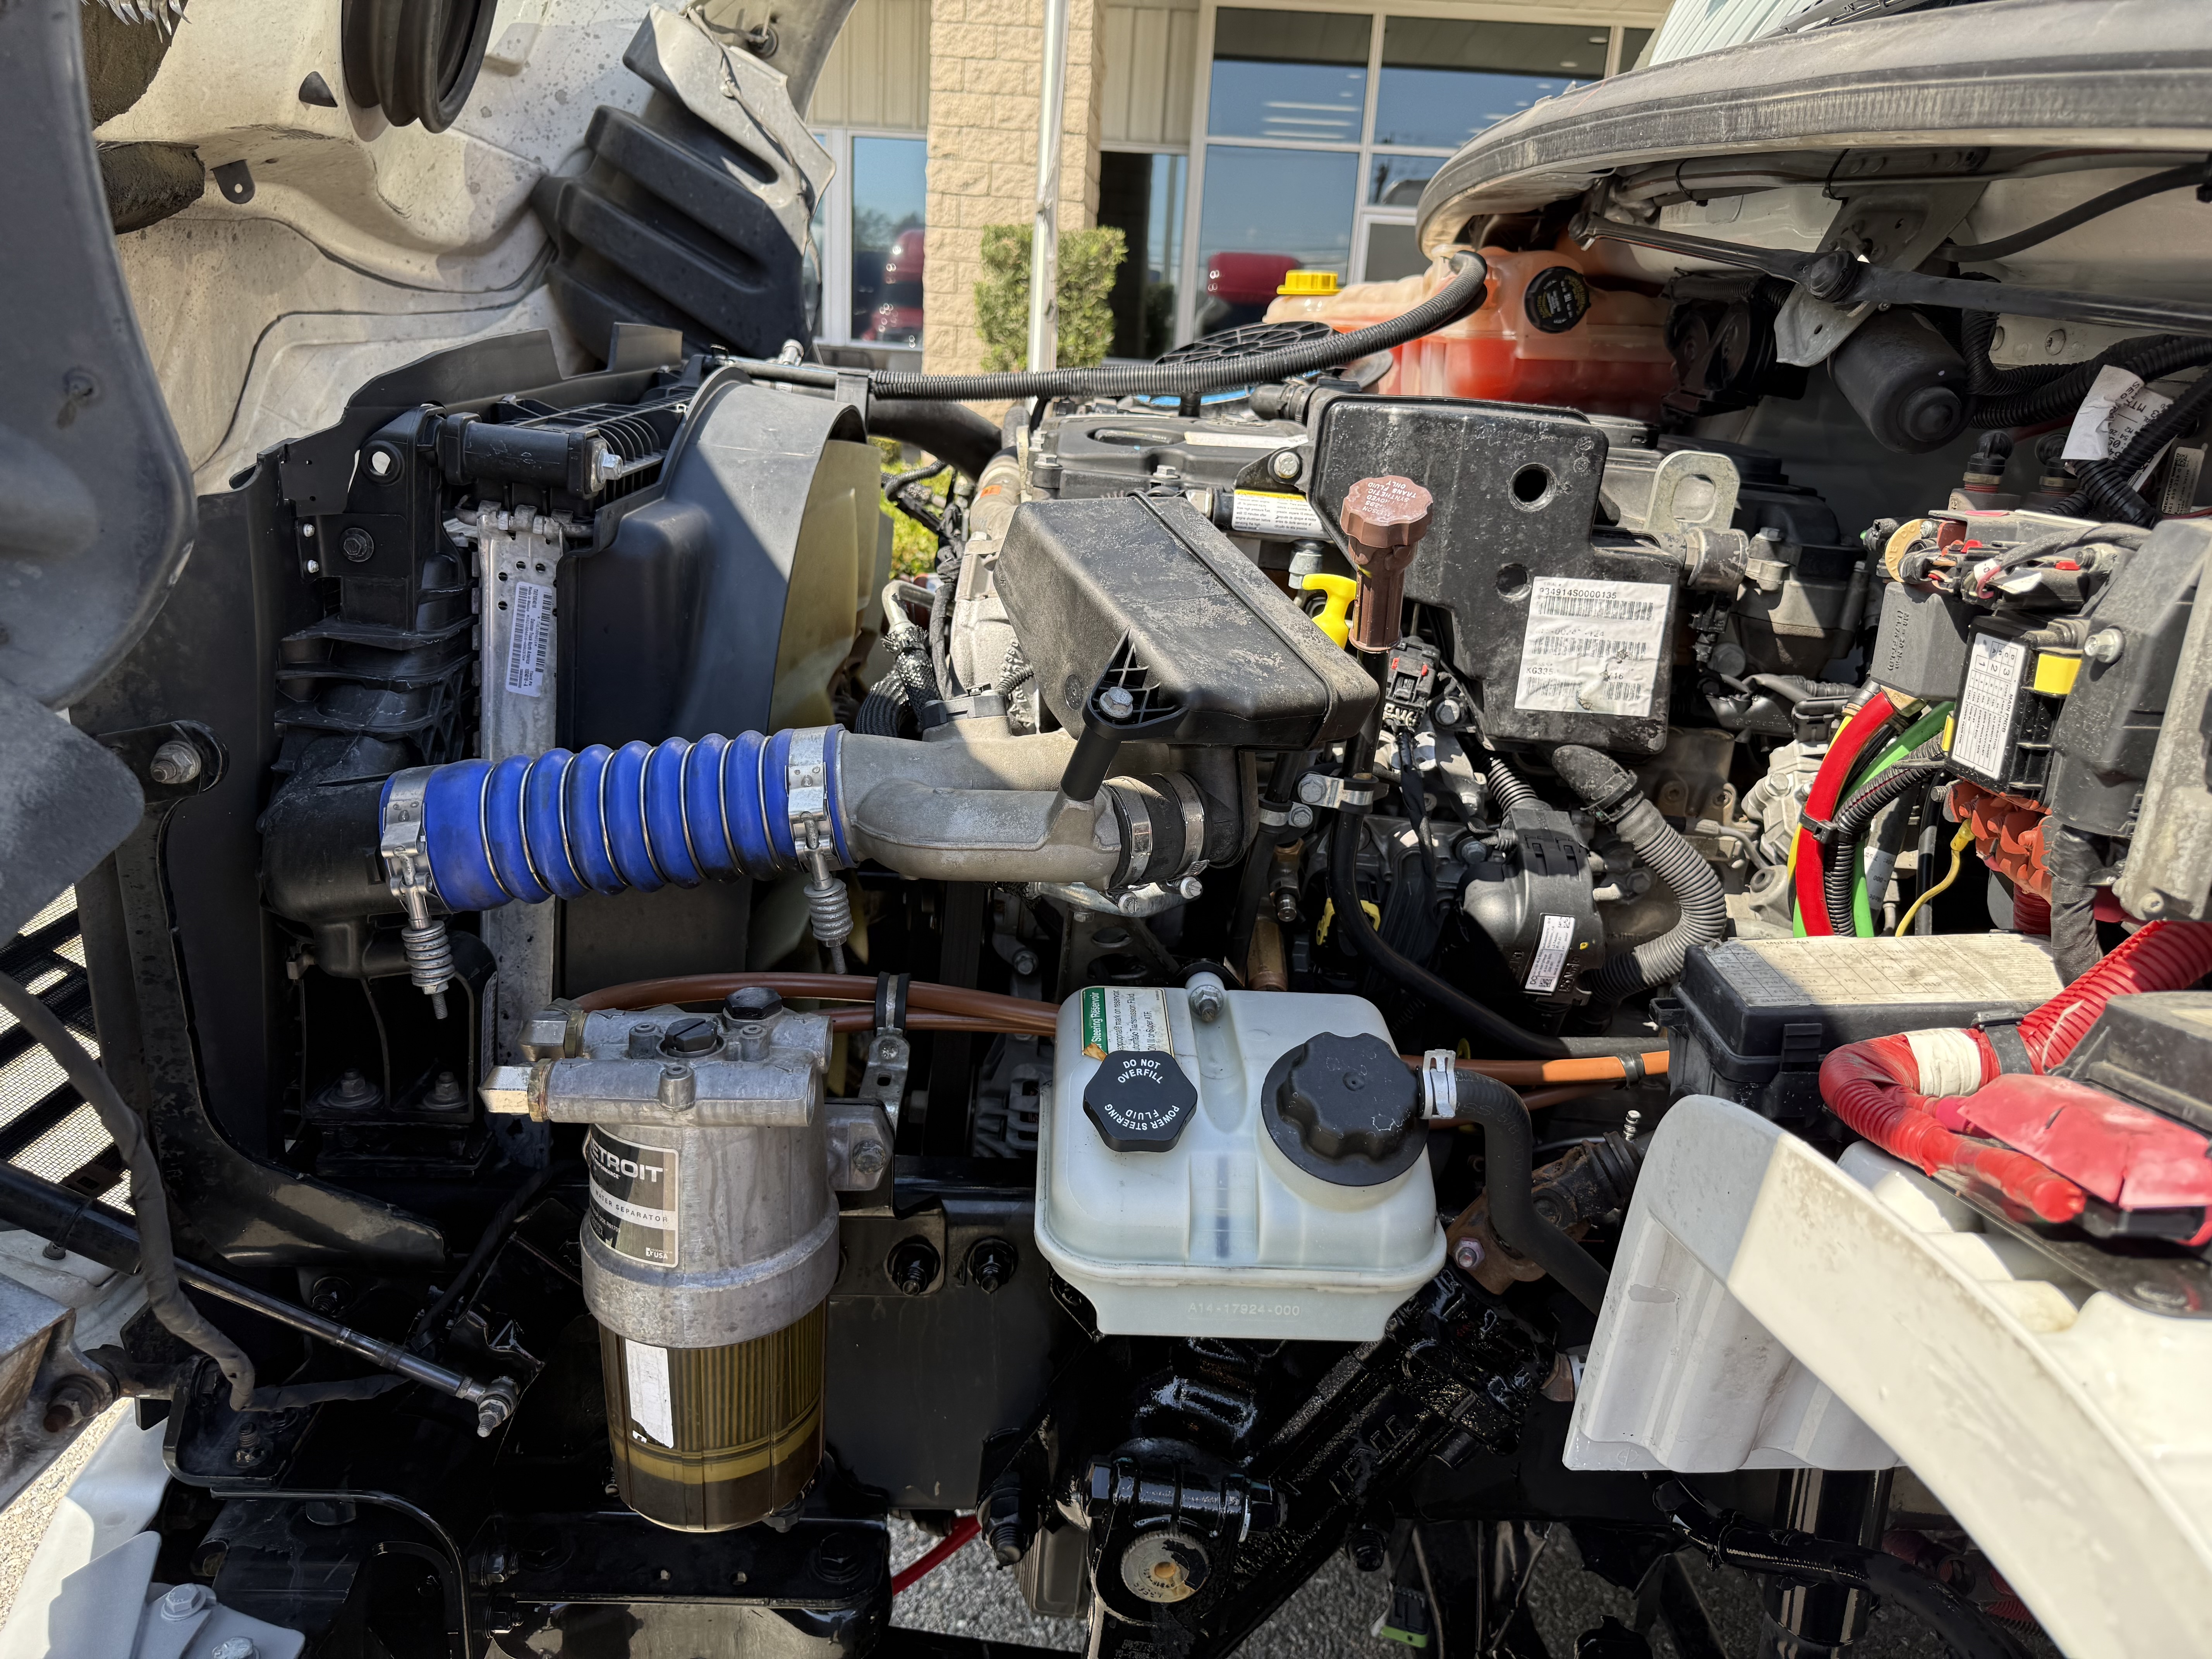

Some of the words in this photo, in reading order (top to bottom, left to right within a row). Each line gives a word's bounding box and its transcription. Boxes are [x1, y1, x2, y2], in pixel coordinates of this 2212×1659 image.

[2120, 381, 2140, 399] SEQ
[1368, 482, 1389, 491] FLUID
[1386, 480, 1407, 489] ONLY
[1368, 488, 1410, 503] SYNTHETIC
[1391, 488, 1416, 498] TRANS
[2002, 668, 2010, 676] 3
[1529, 975, 1538, 985] DC
[1090, 991, 1100, 1017] Reservoir
[1129, 1004, 1137, 1031] Transmission
[1091, 1018, 1103, 1041] Steering
[1145, 1020, 1155, 1032] Super
[1114, 1026, 1125, 1050] appropriate
[1128, 1032, 1140, 1051] utomatic
[1123, 1059, 1137, 1068] DO
[1141, 1059, 1161, 1069] NOT
[1118, 1068, 1163, 1084] OVERFILL
[1104, 1104, 1148, 1130] STEERING
[1125, 1109, 1159, 1120] FLUID
[1150, 1105, 1180, 1129] POWER
[596, 1190, 613, 1207] WATER
[616, 1204, 668, 1223] SEPARATOR
[1188, 1302, 1300, 1316] A14-17924-000
